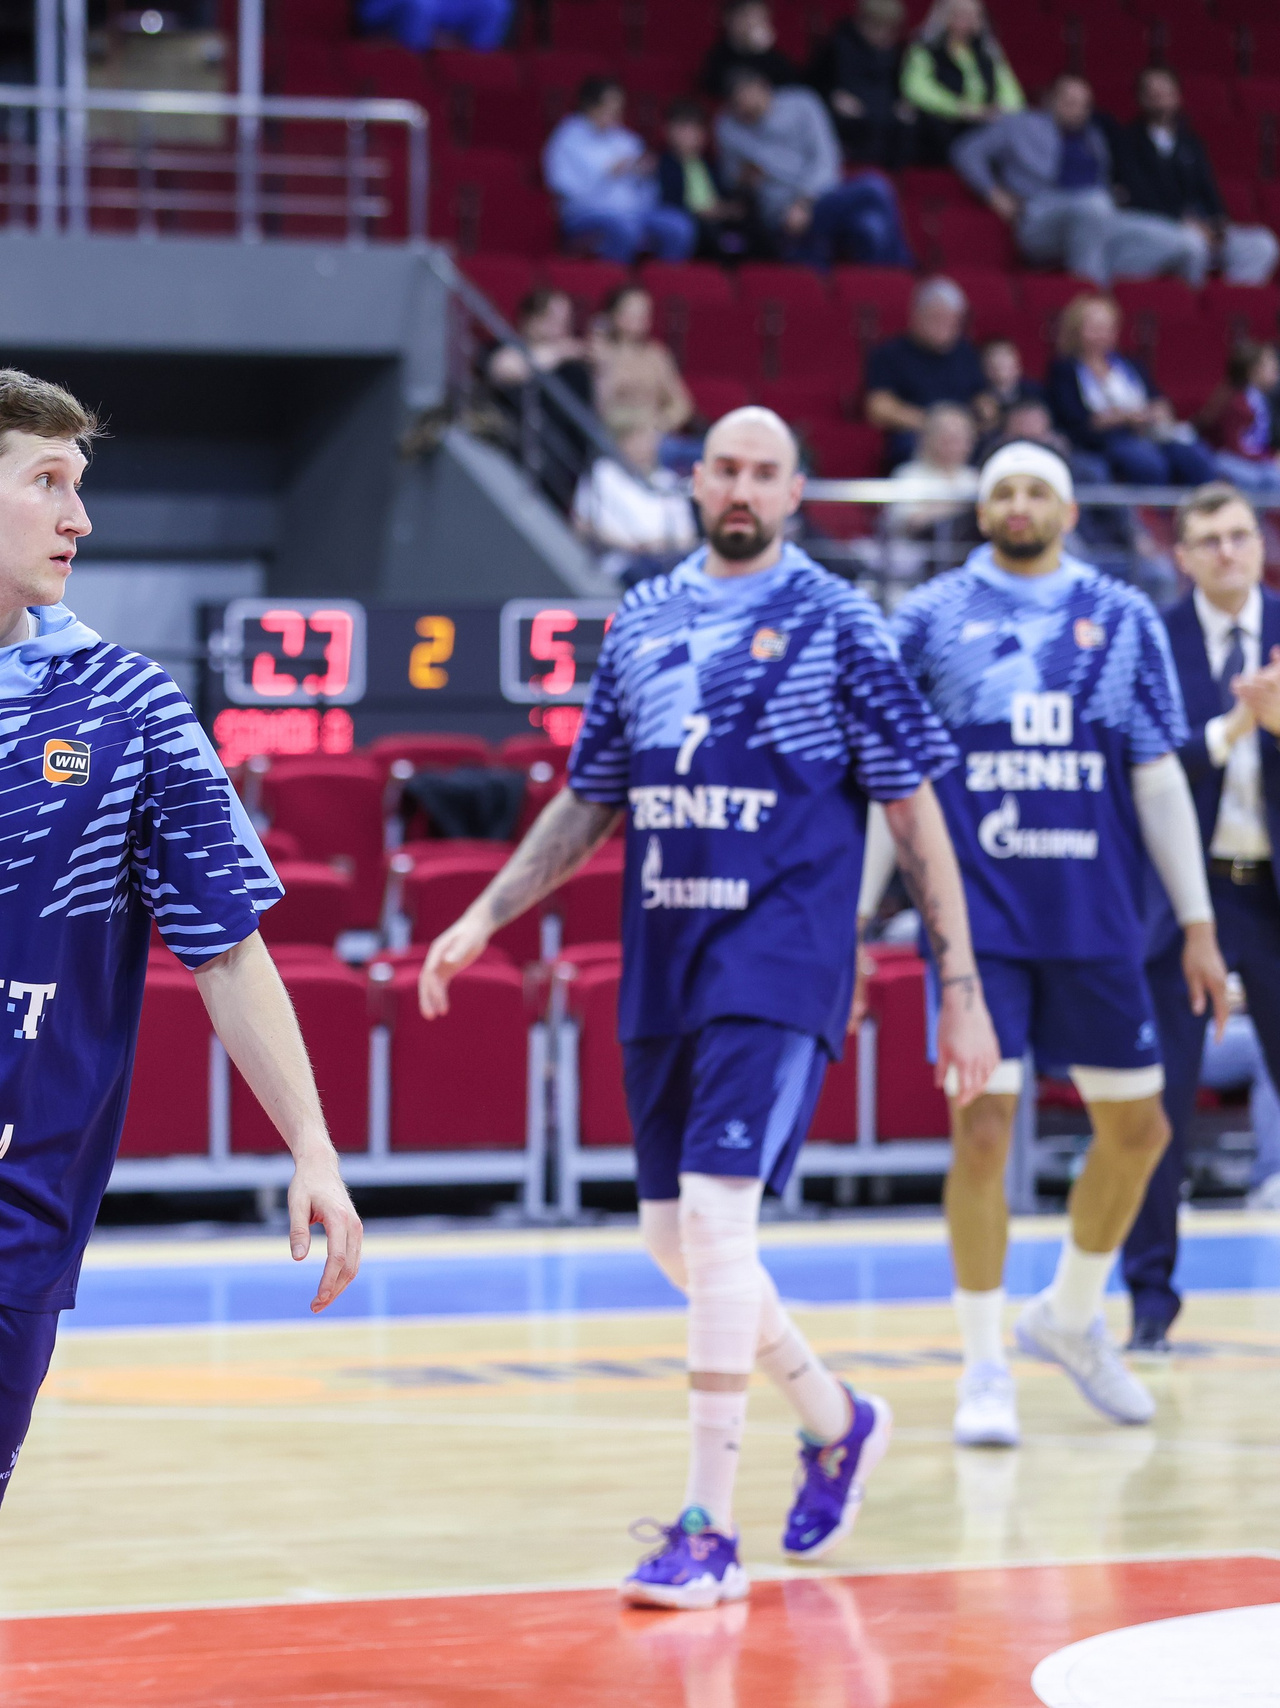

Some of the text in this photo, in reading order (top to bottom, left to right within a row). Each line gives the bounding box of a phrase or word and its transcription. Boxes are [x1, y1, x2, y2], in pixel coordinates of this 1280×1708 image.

[408, 615, 456, 690] 2
[674, 713, 711, 776] 7
[1010, 690, 1074, 747] 00
[55, 755, 86, 770] WIN
[965, 750, 1106, 792] ZENIT
